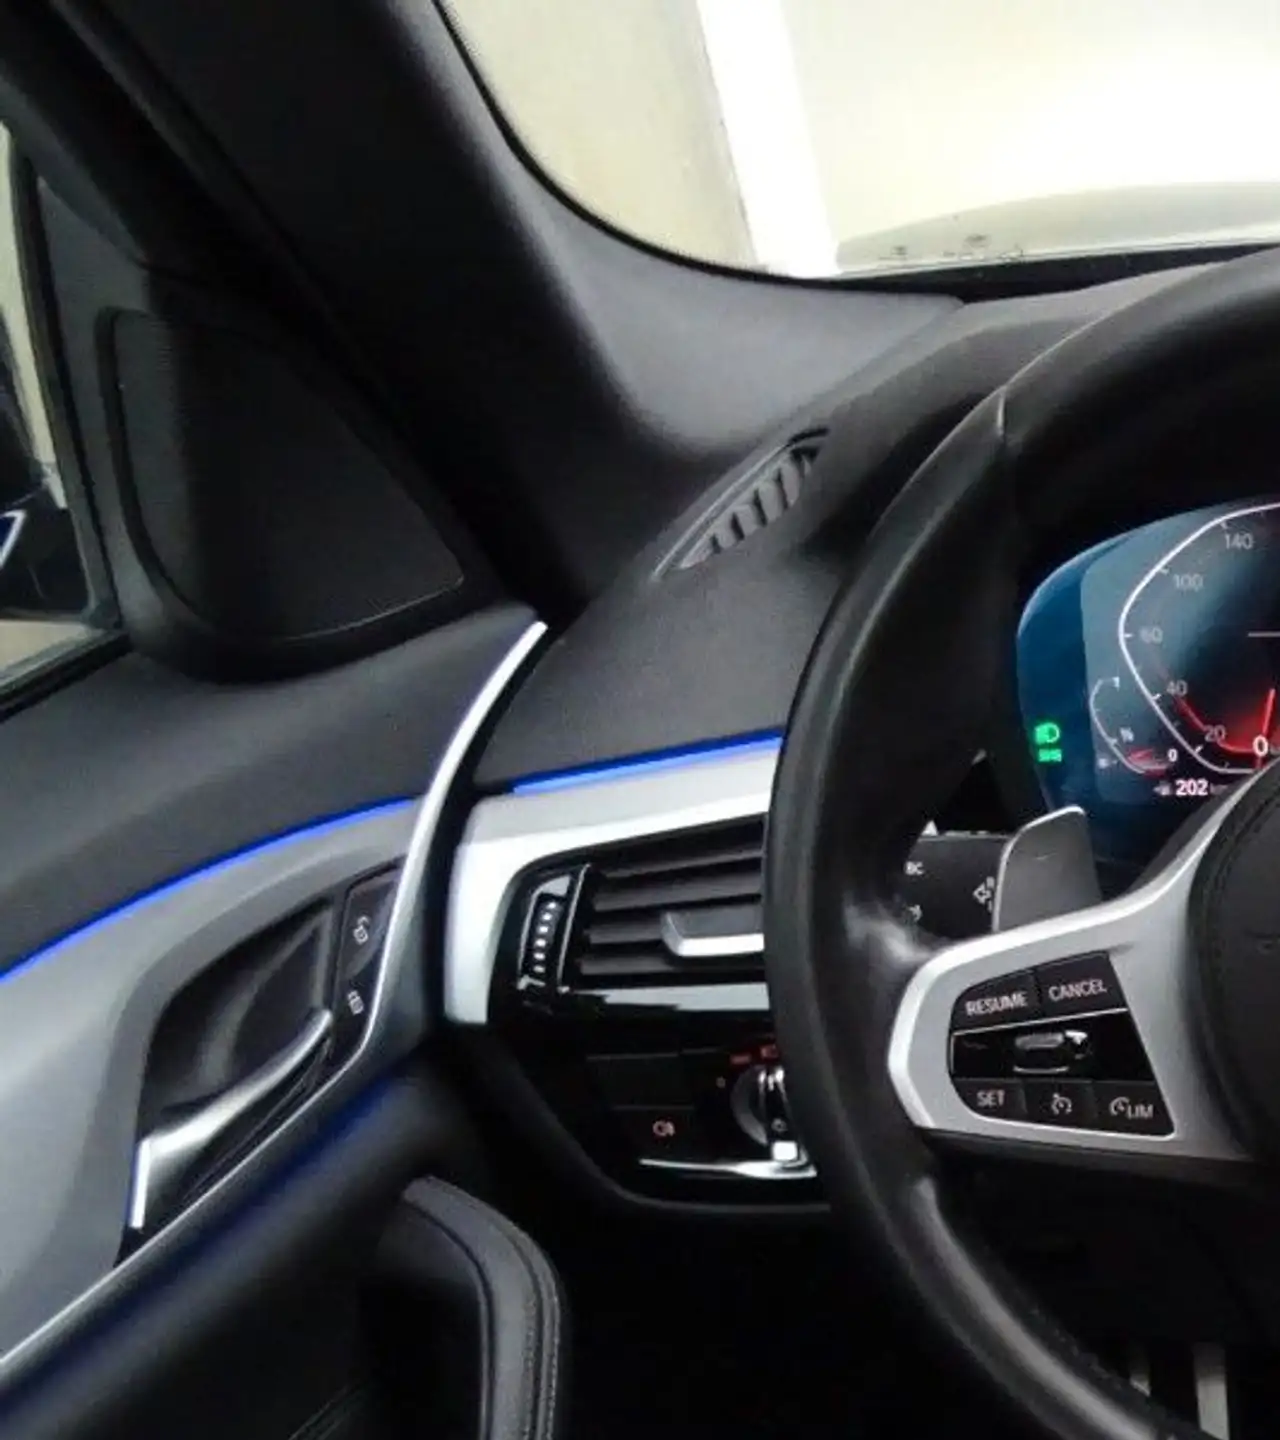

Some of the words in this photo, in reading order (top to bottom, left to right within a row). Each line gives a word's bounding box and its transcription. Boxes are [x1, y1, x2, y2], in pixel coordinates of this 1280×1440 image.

[1224, 533, 1255, 551] 140
[1173, 573, 1205, 590] 100
[1141, 627, 1163, 645] 60
[1166, 680, 1188, 696] 40
[1205, 725, 1226, 742] 20
[1252, 734, 1269, 757] 0
[1175, 779, 1209, 796] 202
[1048, 978, 1108, 1001] CANCEL
[965, 991, 1028, 1017] RESUME
[976, 1089, 1006, 1108] SET
[1126, 1103, 1154, 1119] LIM
